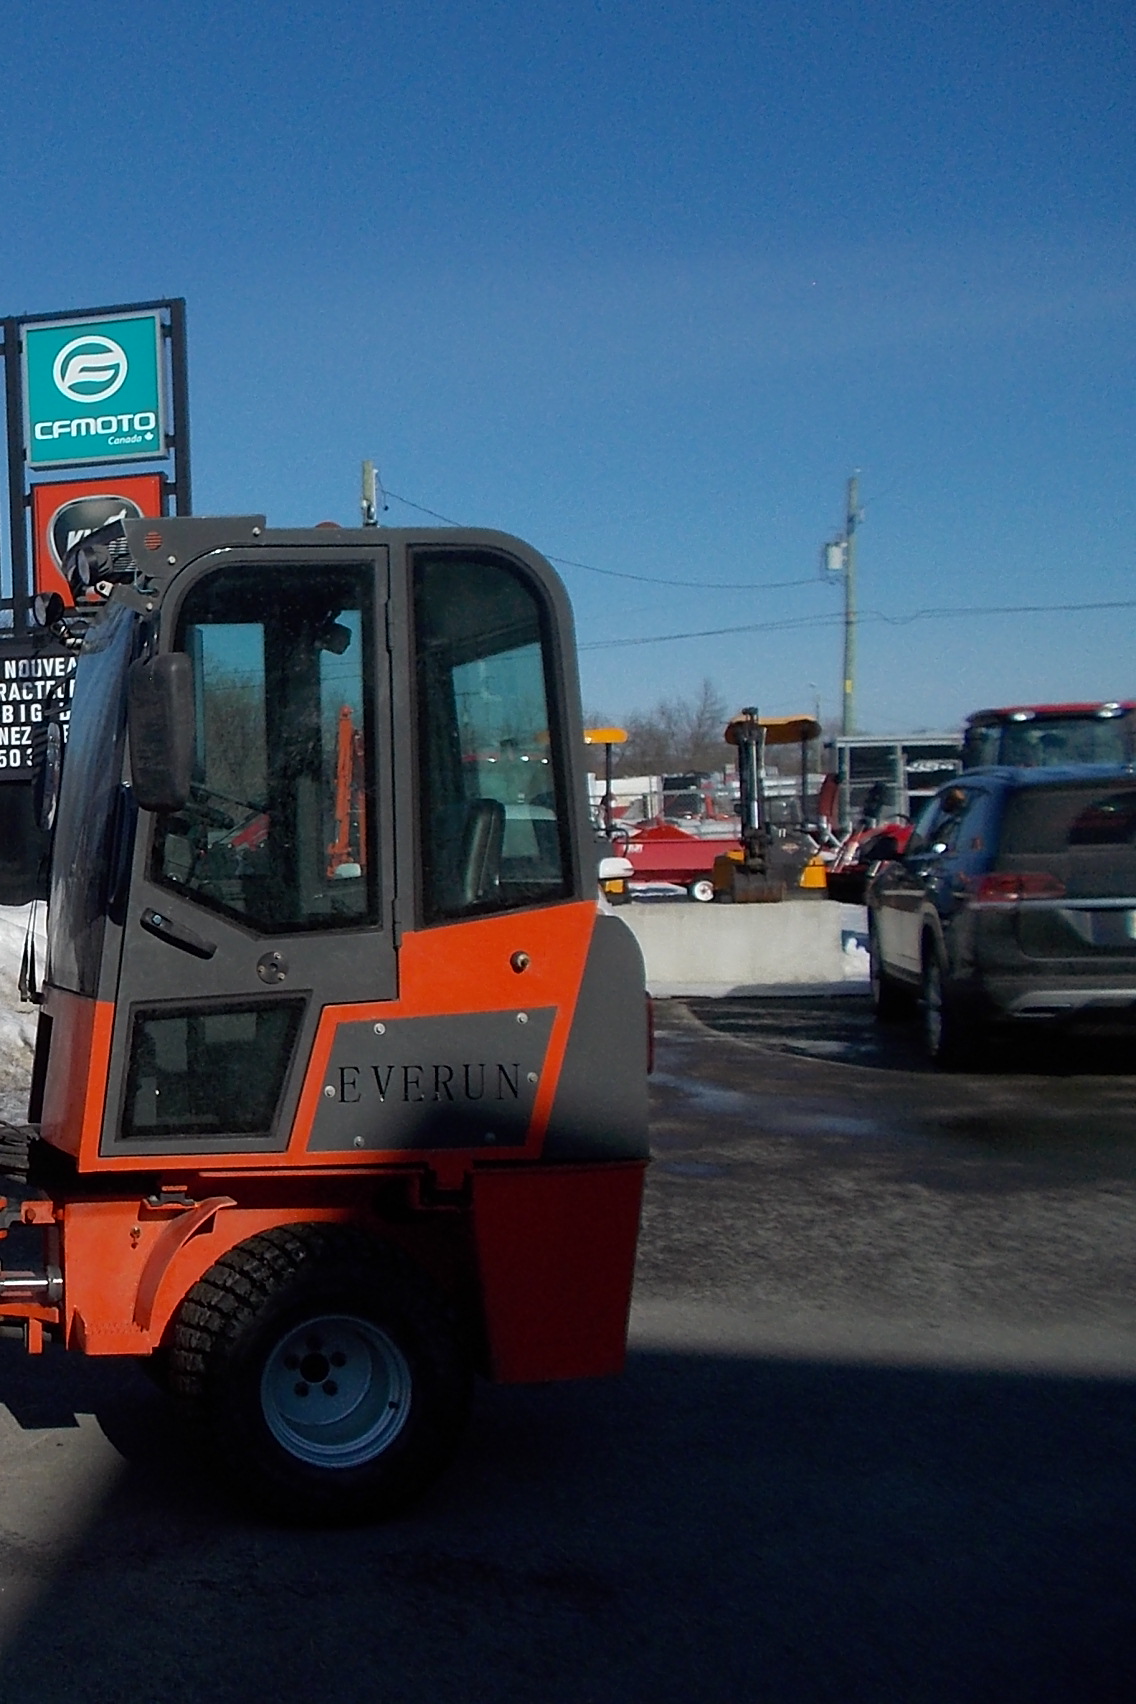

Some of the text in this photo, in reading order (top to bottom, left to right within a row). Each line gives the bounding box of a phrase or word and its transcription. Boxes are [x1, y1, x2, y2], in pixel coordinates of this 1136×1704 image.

[34, 412, 156, 440] CFMOTO
[107, 434, 143, 446] Canada
[338, 1063, 521, 1103] EVERUN
